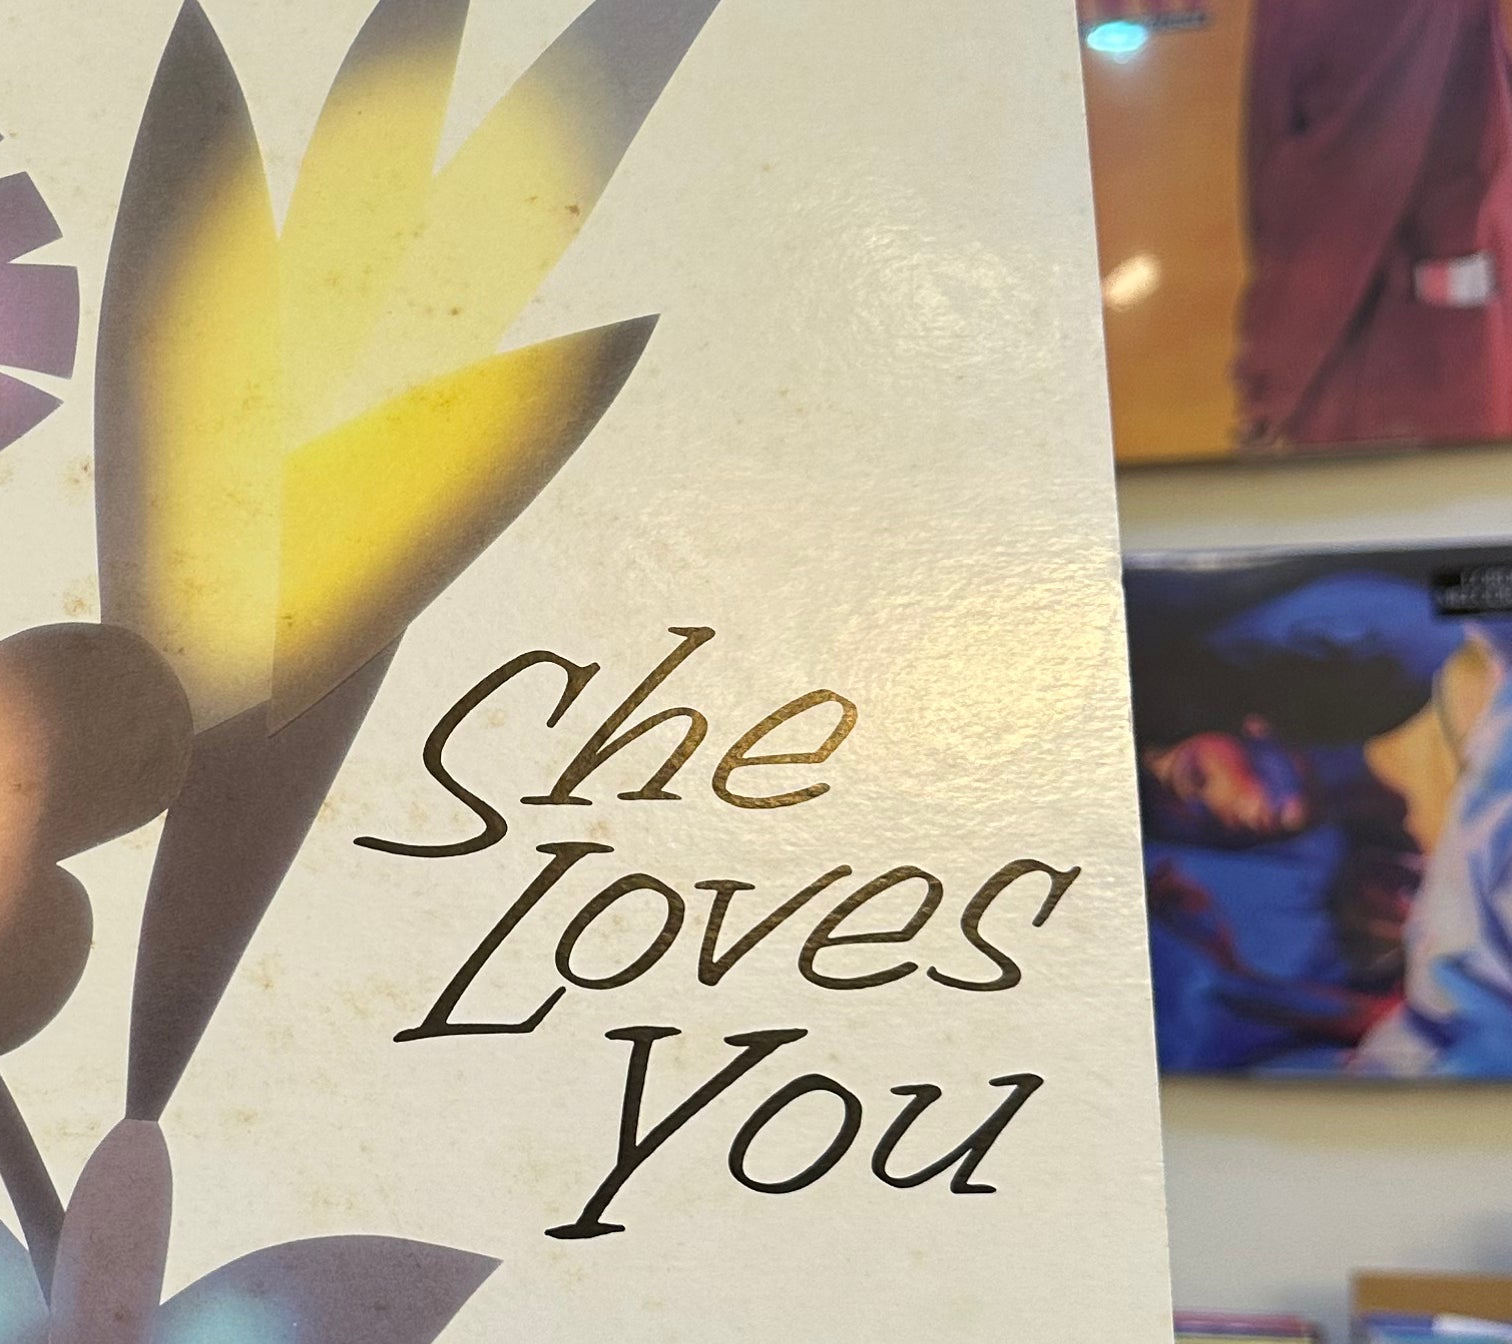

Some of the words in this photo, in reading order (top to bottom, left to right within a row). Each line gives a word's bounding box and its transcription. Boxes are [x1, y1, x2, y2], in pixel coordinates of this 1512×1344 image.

[352, 625, 858, 858] She
[392, 841, 1082, 1043] Loves
[544, 1025, 1045, 1240] You
